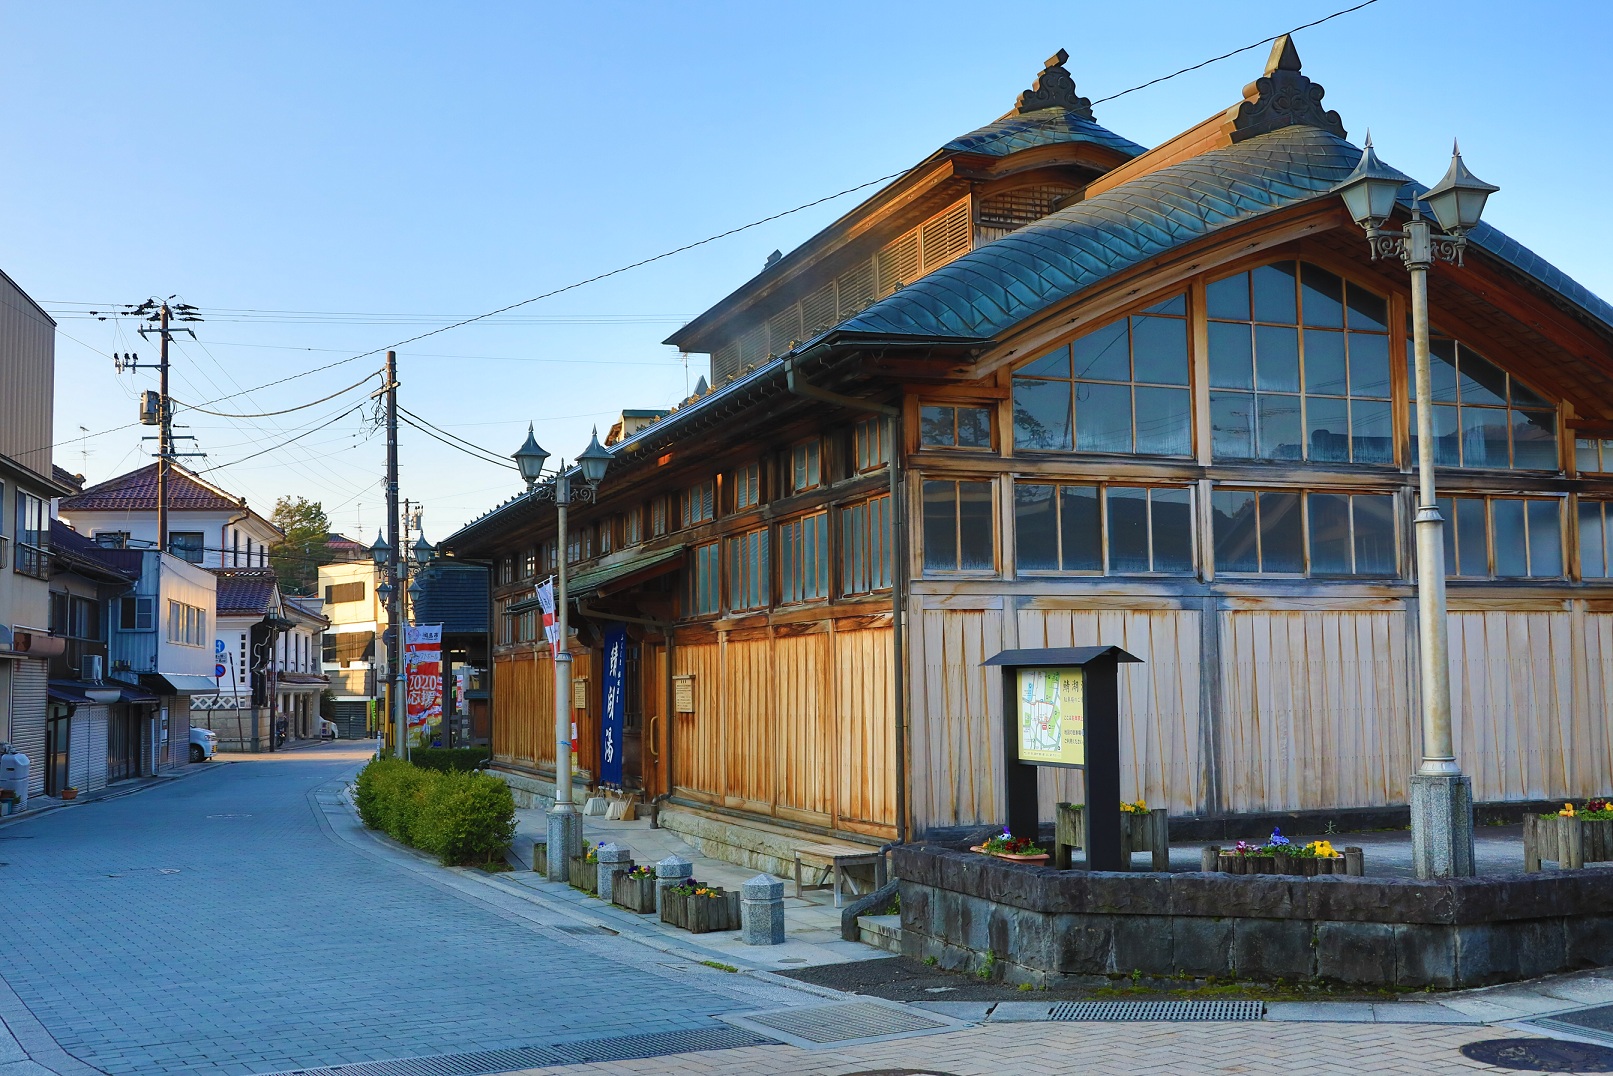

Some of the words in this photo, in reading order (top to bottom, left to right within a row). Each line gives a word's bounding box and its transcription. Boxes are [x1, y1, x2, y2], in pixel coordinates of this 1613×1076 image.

[409, 675, 437, 690] 2020
[1063, 679, 1083, 693] 鯖湖
[407, 690, 436, 708] 応援
